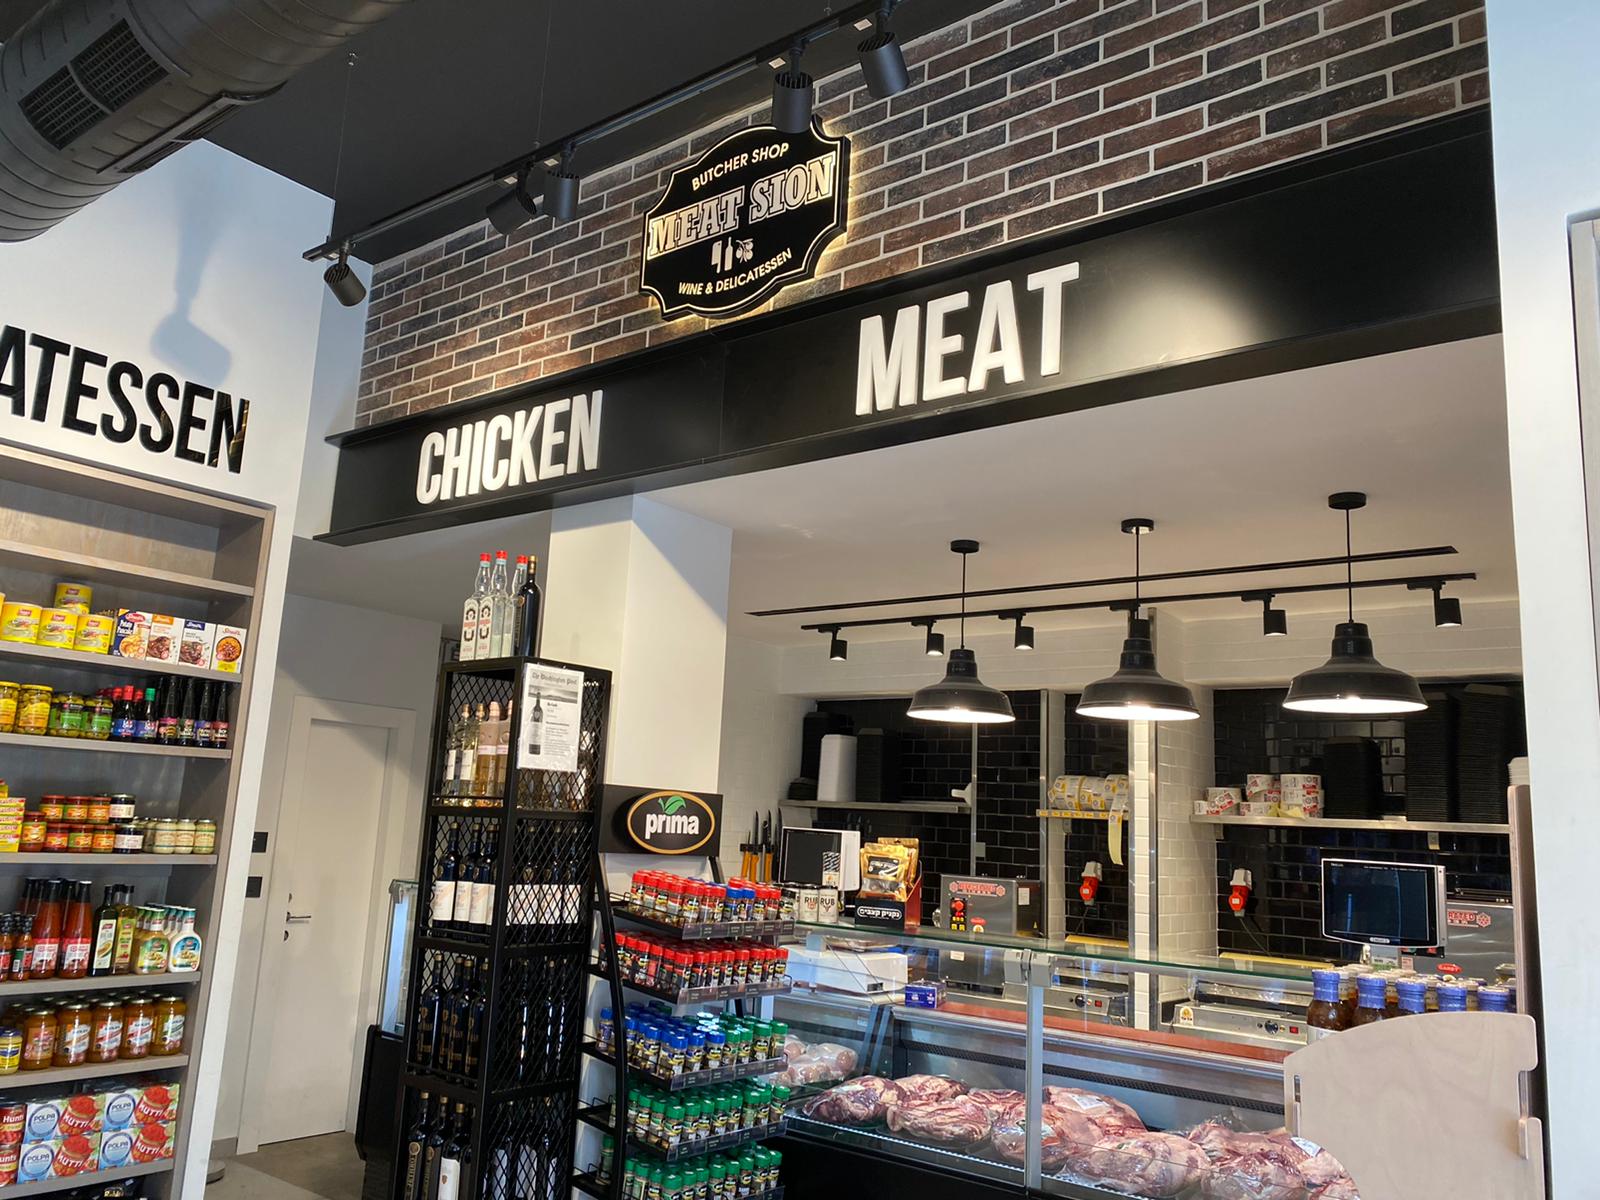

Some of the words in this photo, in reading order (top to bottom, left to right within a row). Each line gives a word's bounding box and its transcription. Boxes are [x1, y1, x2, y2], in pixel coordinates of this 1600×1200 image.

[692, 153, 748, 191] BUTCHER
[752, 142, 790, 164] SHOP
[647, 185, 745, 260] MEAT
[749, 151, 836, 224] SION
[678, 282, 702, 295] WINE
[705, 284, 713, 294] &
[716, 248, 793, 292] DELICATESSEN
[855, 262, 1080, 416] MEAT
[0, 324, 250, 474] ATESSEN
[416, 389, 604, 505] CHICKEN
[645, 813, 700, 839] prima
[820, 897, 835, 906] RUB
[111, 1102, 131, 1111] POLPA
[138, 1103, 163, 1118] MUTTI
[33, 1113, 56, 1123] POLPA
[63, 1113, 89, 1128] MUTTI
[107, 1140, 129, 1150] POLPA
[135, 1142, 160, 1155] MUTTI
[27, 1153, 50, 1162] POLPA
[57, 1154, 83, 1168] MUTTI
